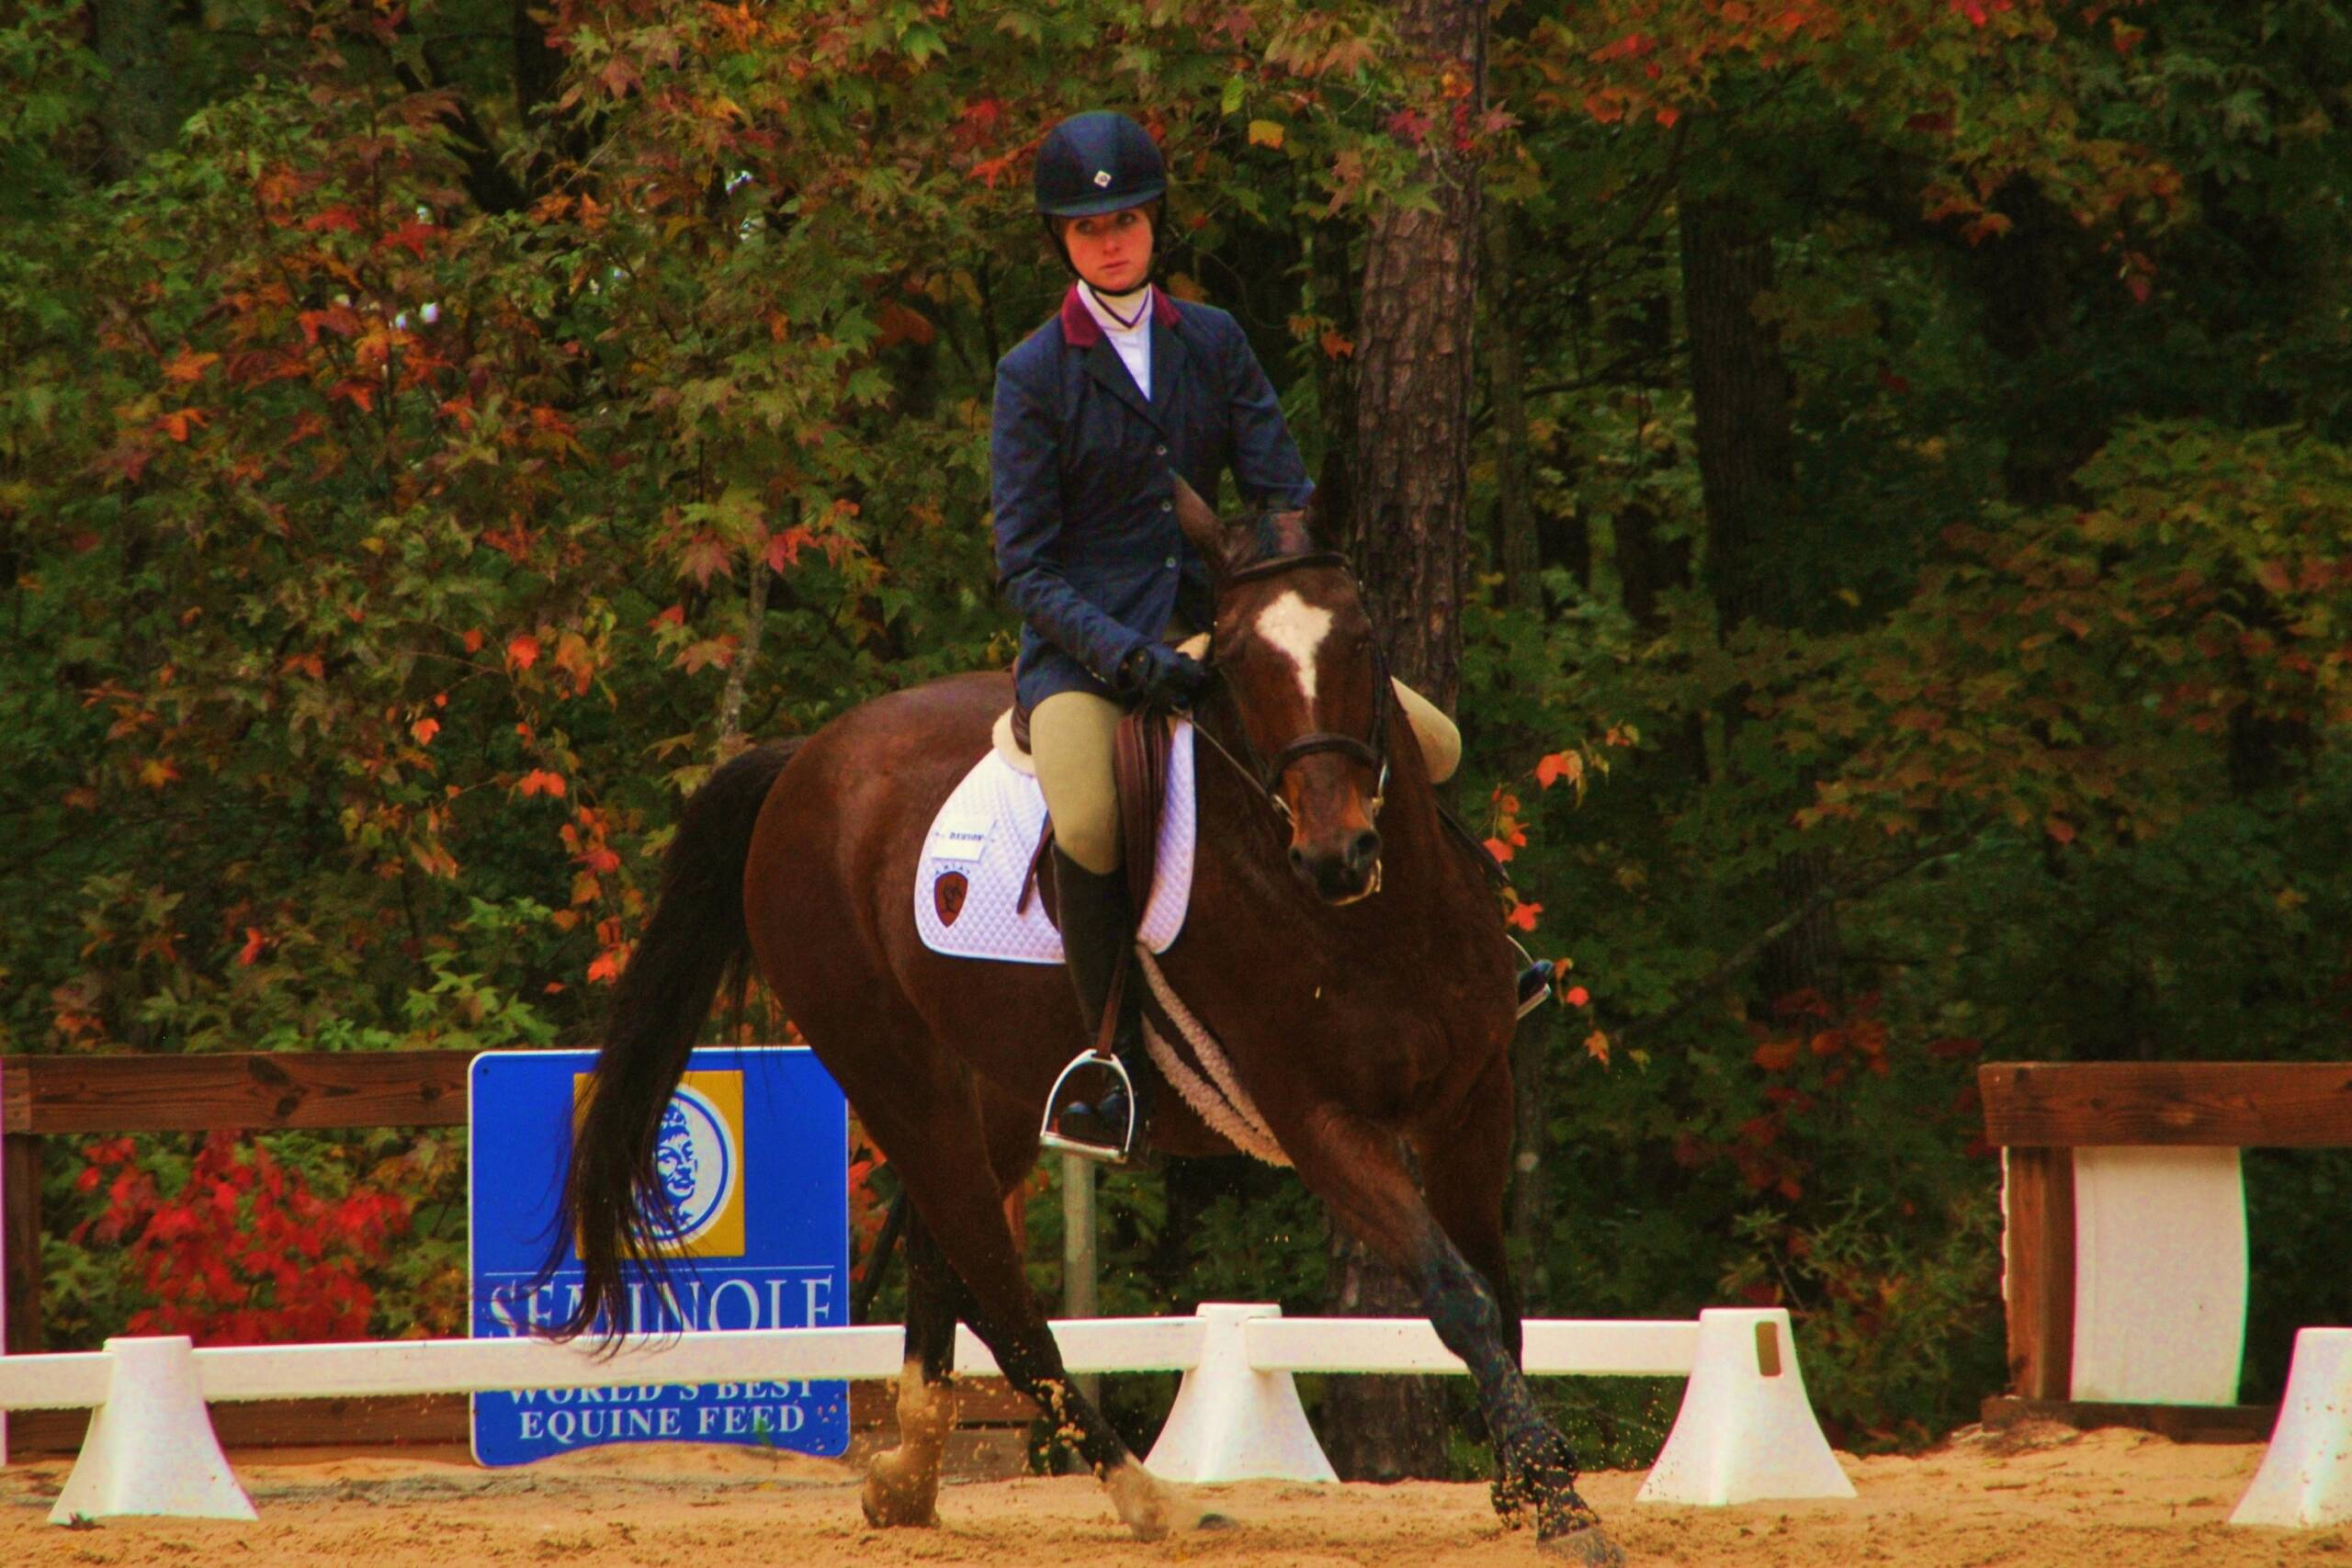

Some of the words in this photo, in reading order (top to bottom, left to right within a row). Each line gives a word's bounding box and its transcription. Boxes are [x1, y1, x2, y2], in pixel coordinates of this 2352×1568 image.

[510, 1384, 699, 1404] WORLDS
[519, 1408, 681, 1444] EQUINE
[698, 1404, 805, 1435] FEED
